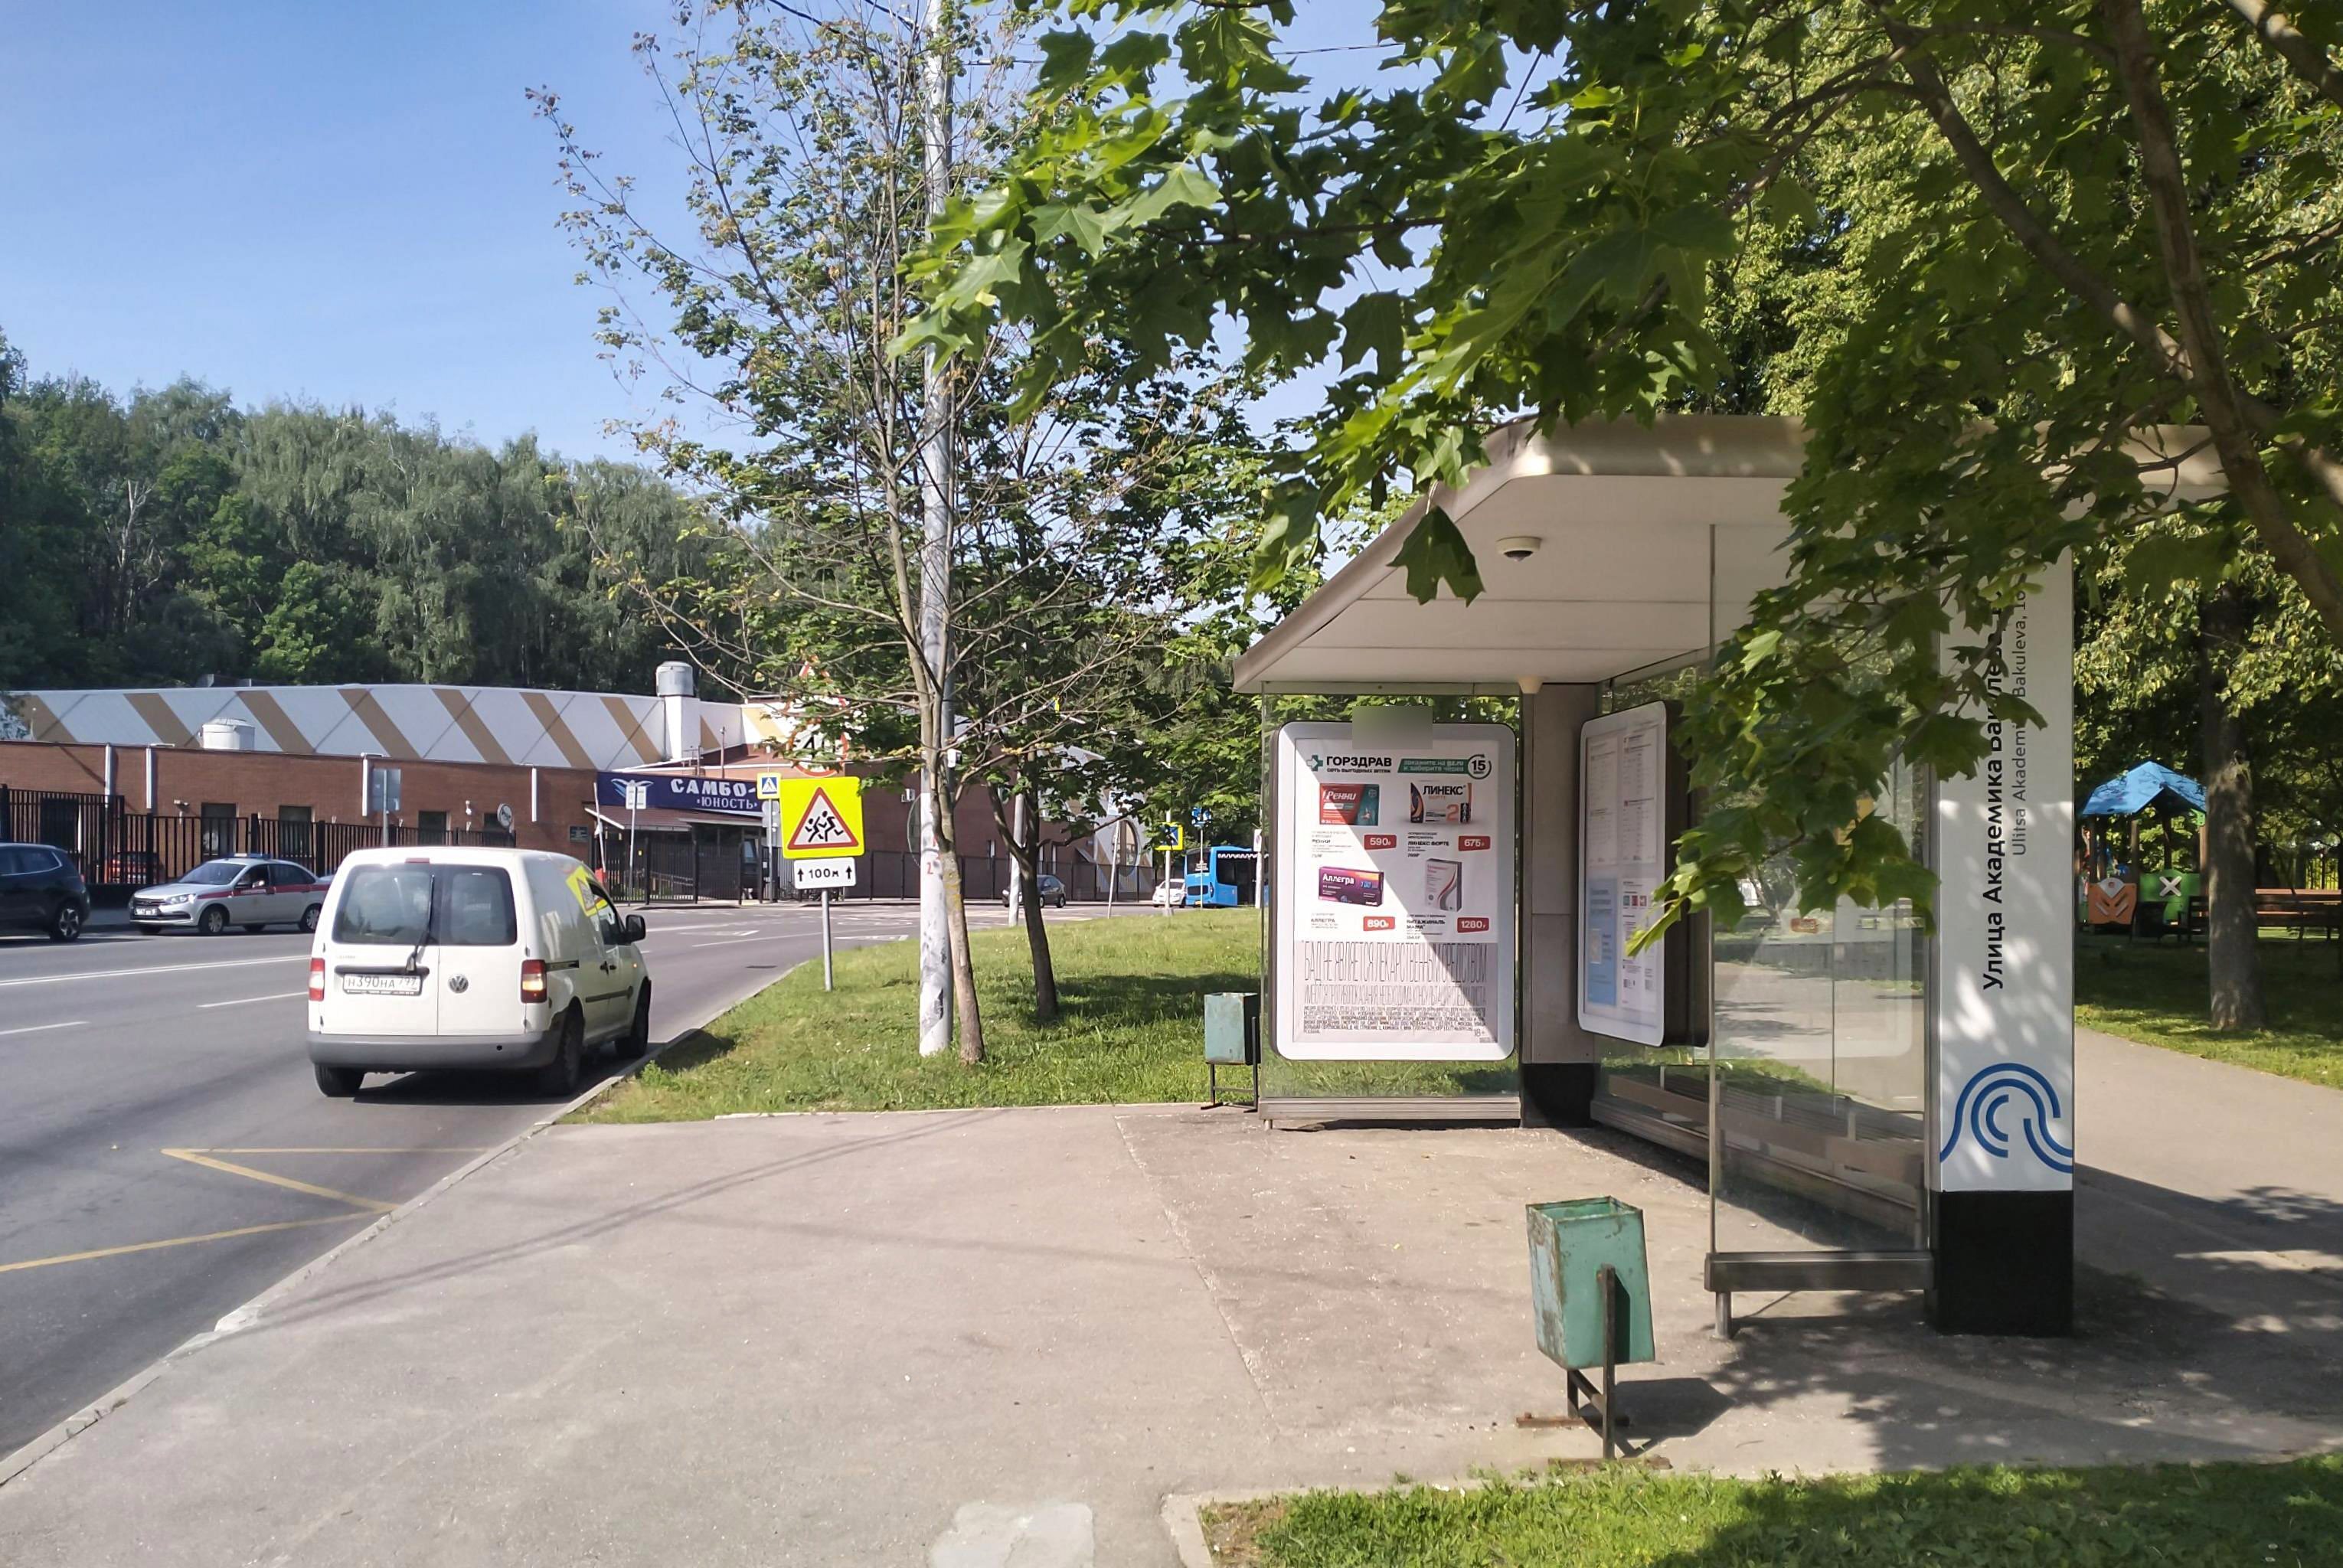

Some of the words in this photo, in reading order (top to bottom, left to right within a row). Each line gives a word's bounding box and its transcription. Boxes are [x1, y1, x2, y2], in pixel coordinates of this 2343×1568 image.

[2011, 616, 2028, 697] Bakuleva,
[1326, 756, 1392, 768] ГОРЗДРАВ
[1471, 760, 1486, 770] 15
[2011, 722, 2026, 802] Akademi
[1423, 785, 1463, 795] ЛИНЕКС
[1982, 760, 2005, 904] Академика
[2011, 808, 2026, 856] Ulitsa
[1322, 873, 1355, 885] Аллегра
[1982, 912, 2005, 990] Улица
